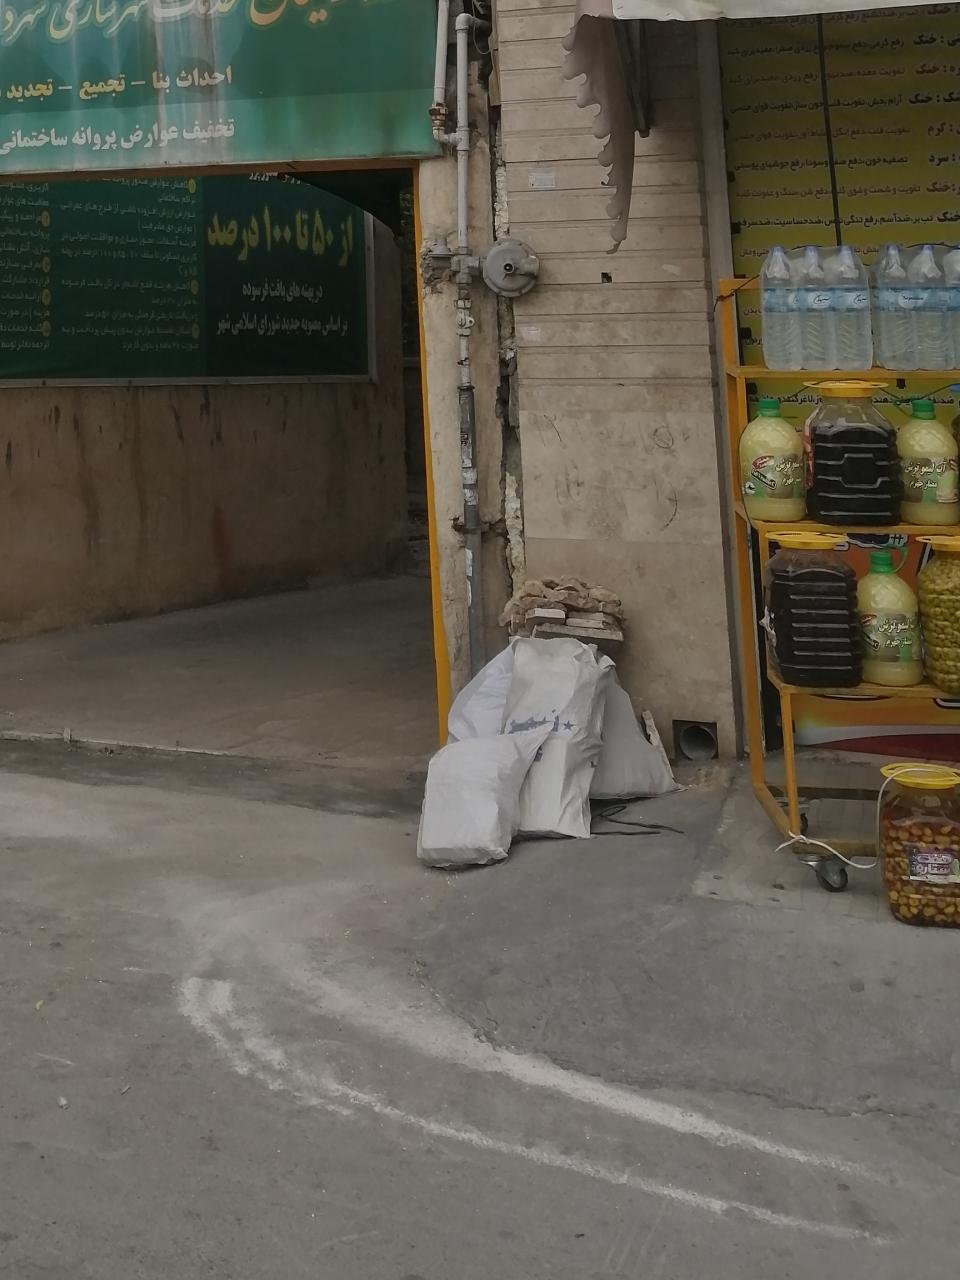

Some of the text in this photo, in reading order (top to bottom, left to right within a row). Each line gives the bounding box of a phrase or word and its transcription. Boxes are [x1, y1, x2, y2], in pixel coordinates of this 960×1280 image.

[79, 73, 126, 100] تجمیع
[152, 70, 171, 95] بنا
[176, 65, 232, 89] احداث
[6, 78, 53, 103] تجدید
[71, 124, 117, 151] پروانه
[120, 122, 178, 149] عوارض
[182, 118, 235, 144] تخفیف
